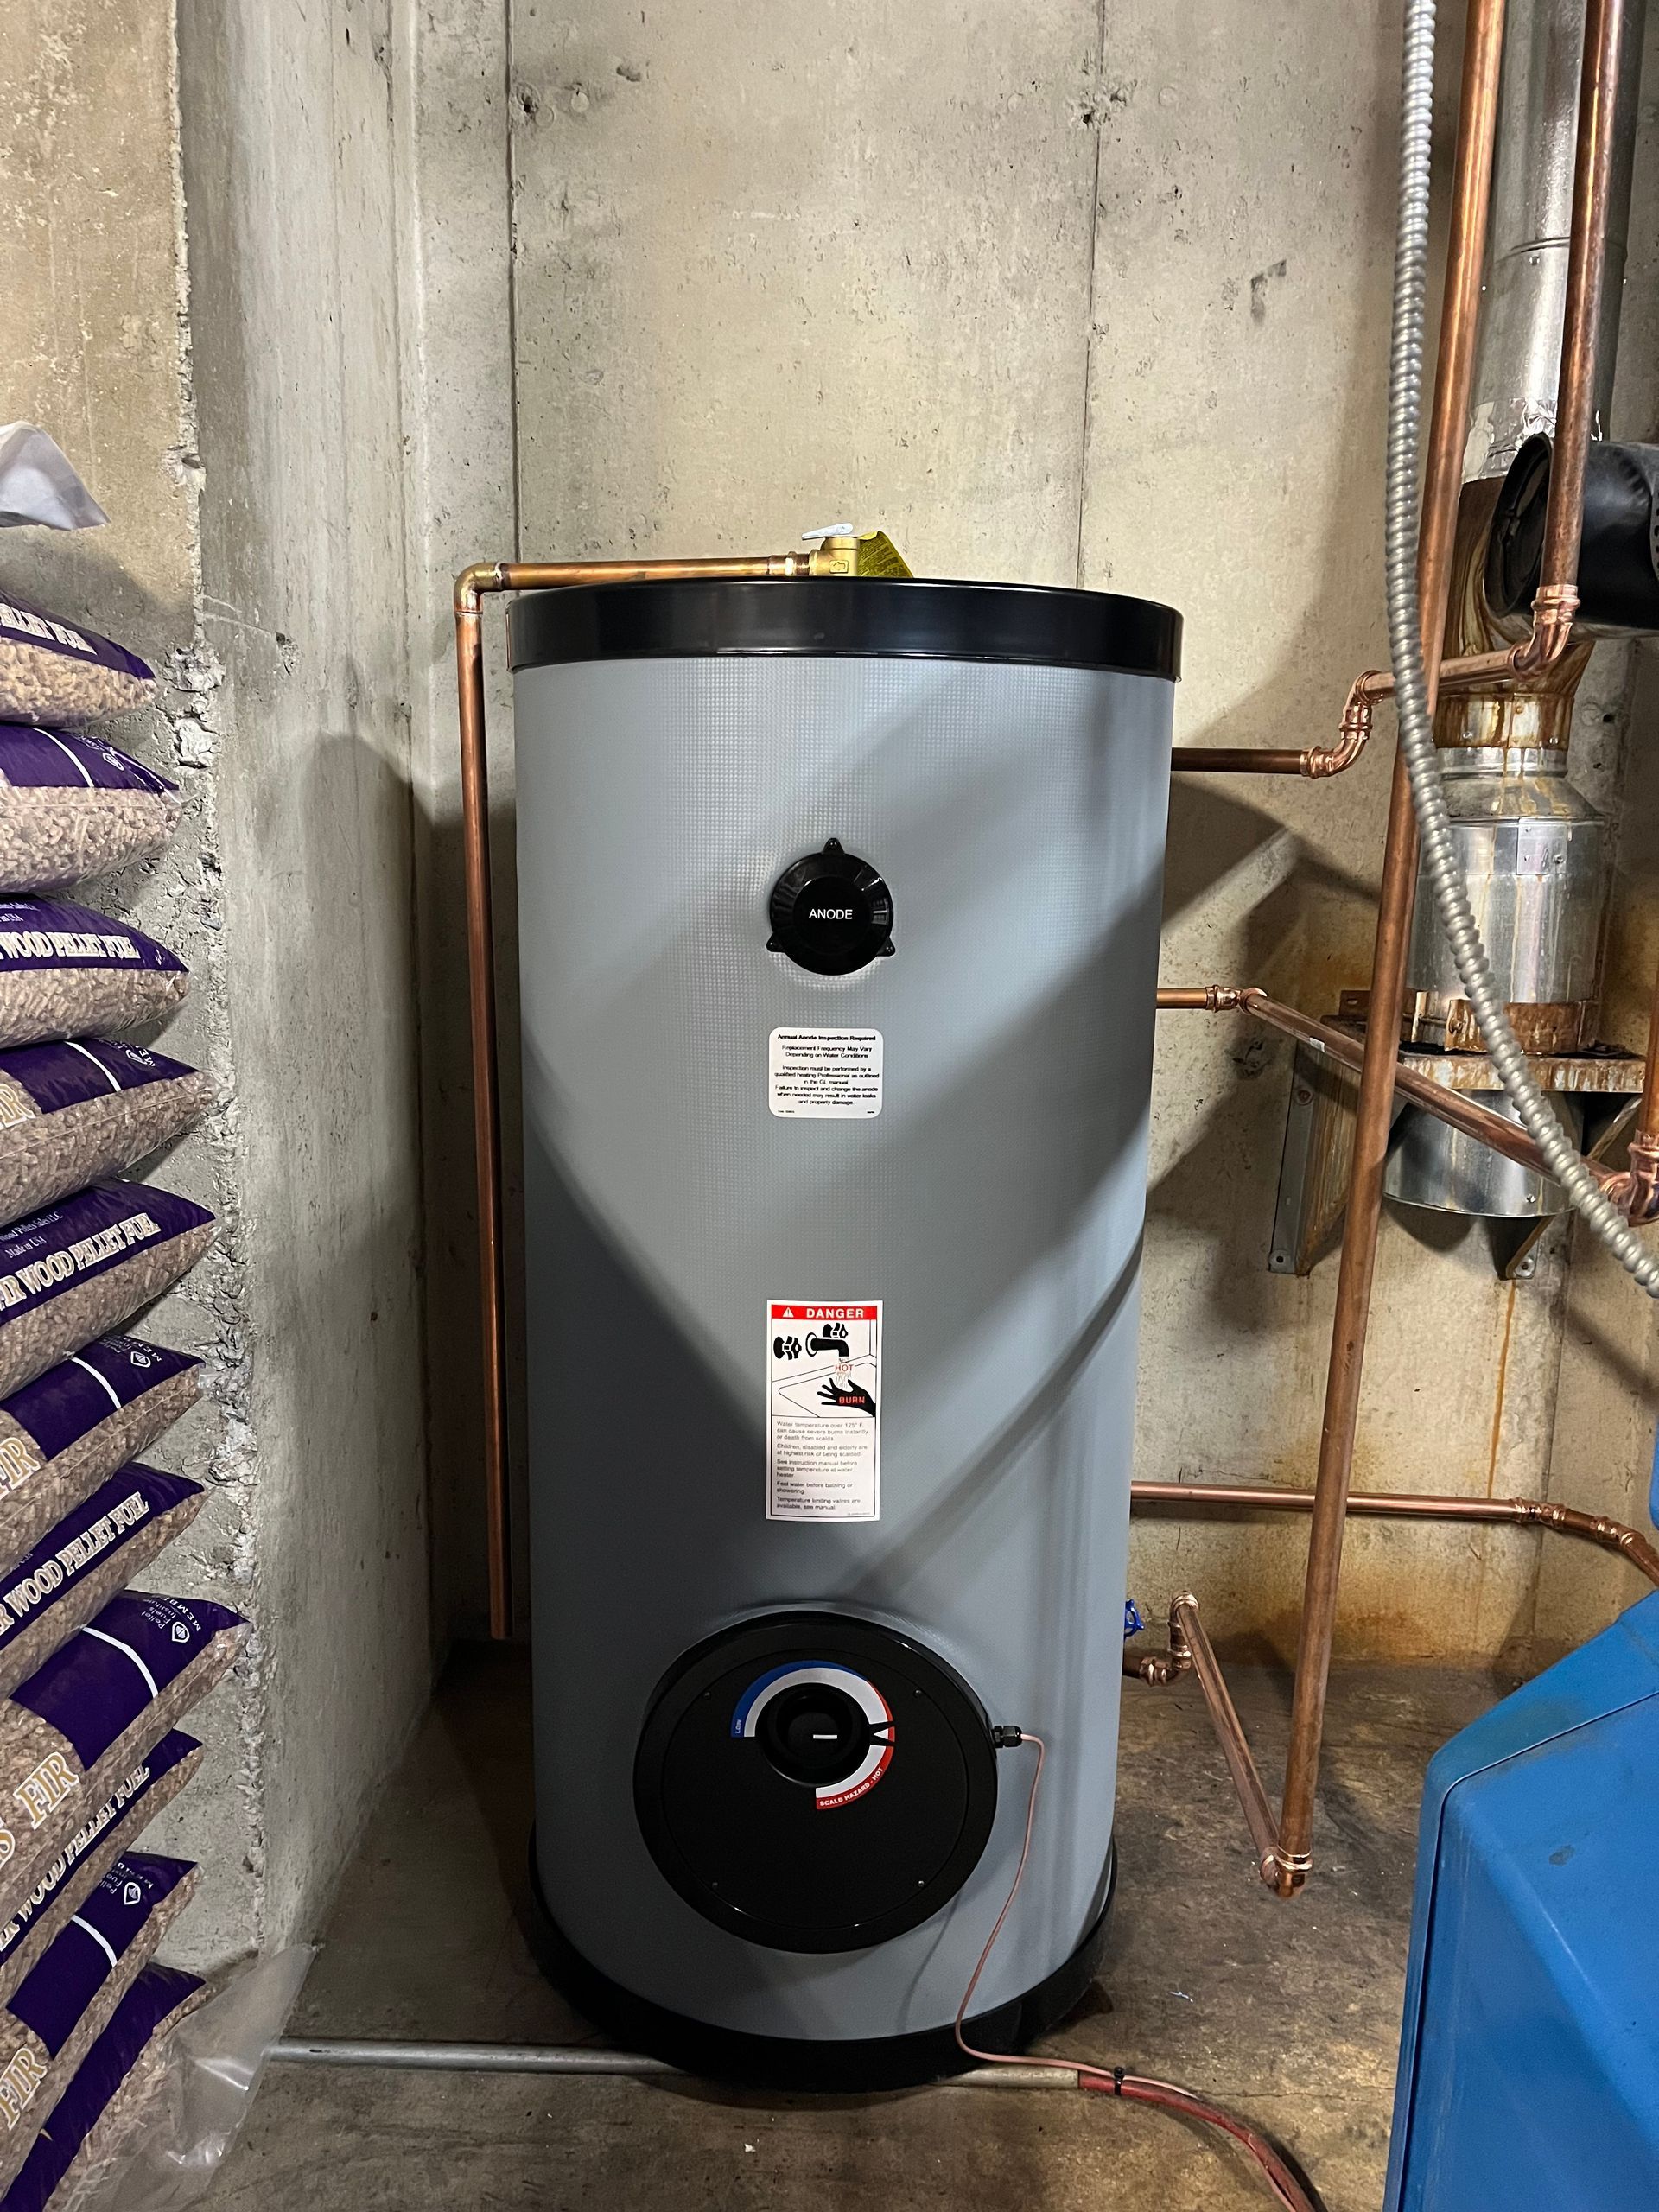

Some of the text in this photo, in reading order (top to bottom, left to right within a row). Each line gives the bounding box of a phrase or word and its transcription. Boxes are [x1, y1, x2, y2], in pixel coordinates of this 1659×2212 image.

[809, 908, 853, 919] ANODE
[0, 931, 141, 959] WOOD PELLET FUEL
[4, 1244, 26, 1259] Made
[15, 1250, 75, 1295] WOOD
[68, 1224, 127, 1271] PELLET
[120, 1212, 162, 1245] FUEL
[806, 1308, 864, 1319] DANGER
[3, 1491, 150, 1618] WOOD PELLET FUEL
[141, 1611, 165, 1630] Pellet
[149, 1606, 171, 1624] Fuels
[13, 1751, 79, 1830] FIR
[114, 1765, 150, 1808] FUEL
[819, 1796, 843, 1806] SCALD
[843, 1782, 870, 1801] HAZARD
[873, 1766, 883, 1781] HOT
[100, 1880, 118, 1895] Pell
